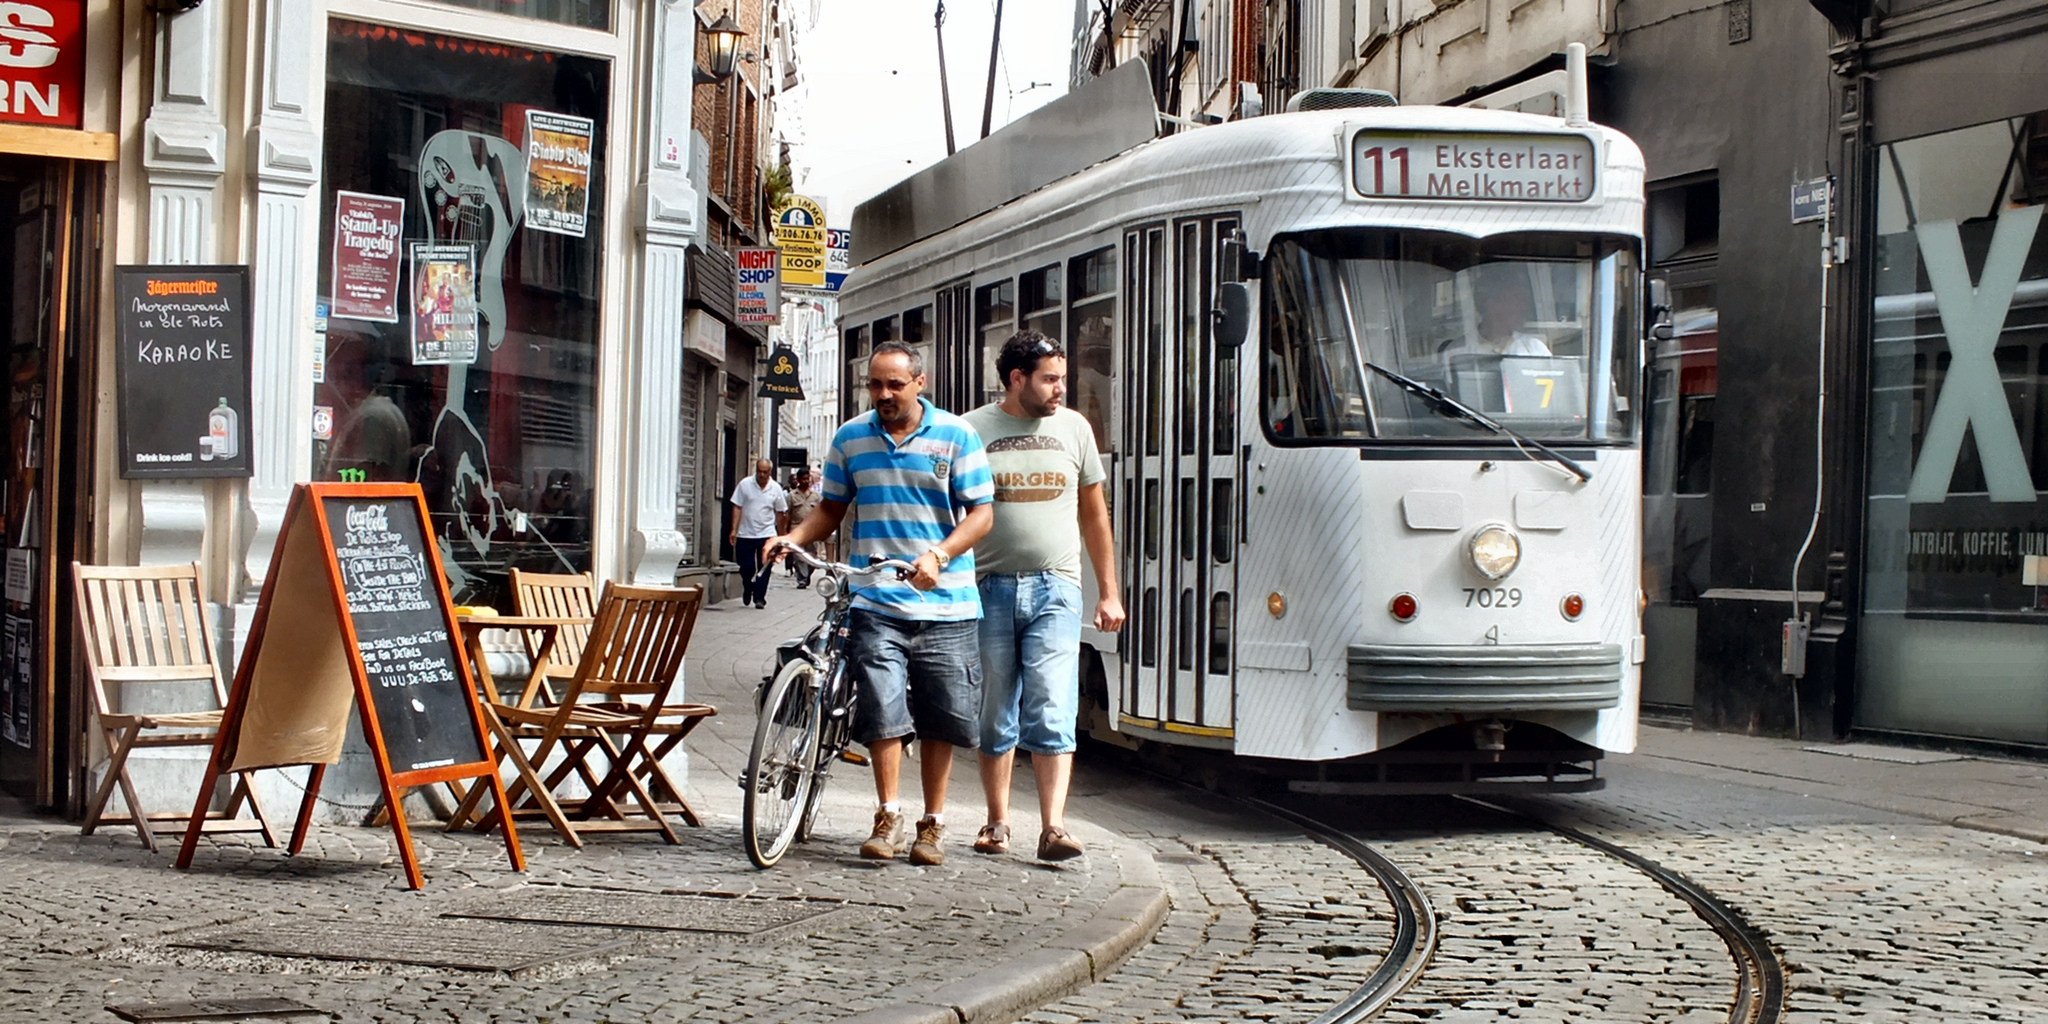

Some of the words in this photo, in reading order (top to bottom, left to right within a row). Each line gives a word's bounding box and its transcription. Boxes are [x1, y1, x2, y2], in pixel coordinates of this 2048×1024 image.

[1363, 146, 1410, 194] 11
[1436, 144, 1583, 170] Eksterlaar
[1427, 173, 1583, 198] Melkmarkt
[798, 198, 824, 226] IMMO
[340, 215, 399, 239] Stand-Up
[343, 231, 394, 255] Tragedy
[738, 250, 776, 269] NIGHT
[786, 258, 822, 268] KOOP
[739, 269, 775, 284] SHOP
[738, 292, 765, 300] ALCOHOL
[138, 339, 233, 365] KARAOKE
[1535, 377, 1555, 409] 7
[136, 453, 158, 463] Drink
[171, 452, 193, 462] cold!
[993, 472, 1067, 487] URGER
[1963, 532, 2012, 559] KOFFIE,
[1462, 587, 1522, 608] 7029
